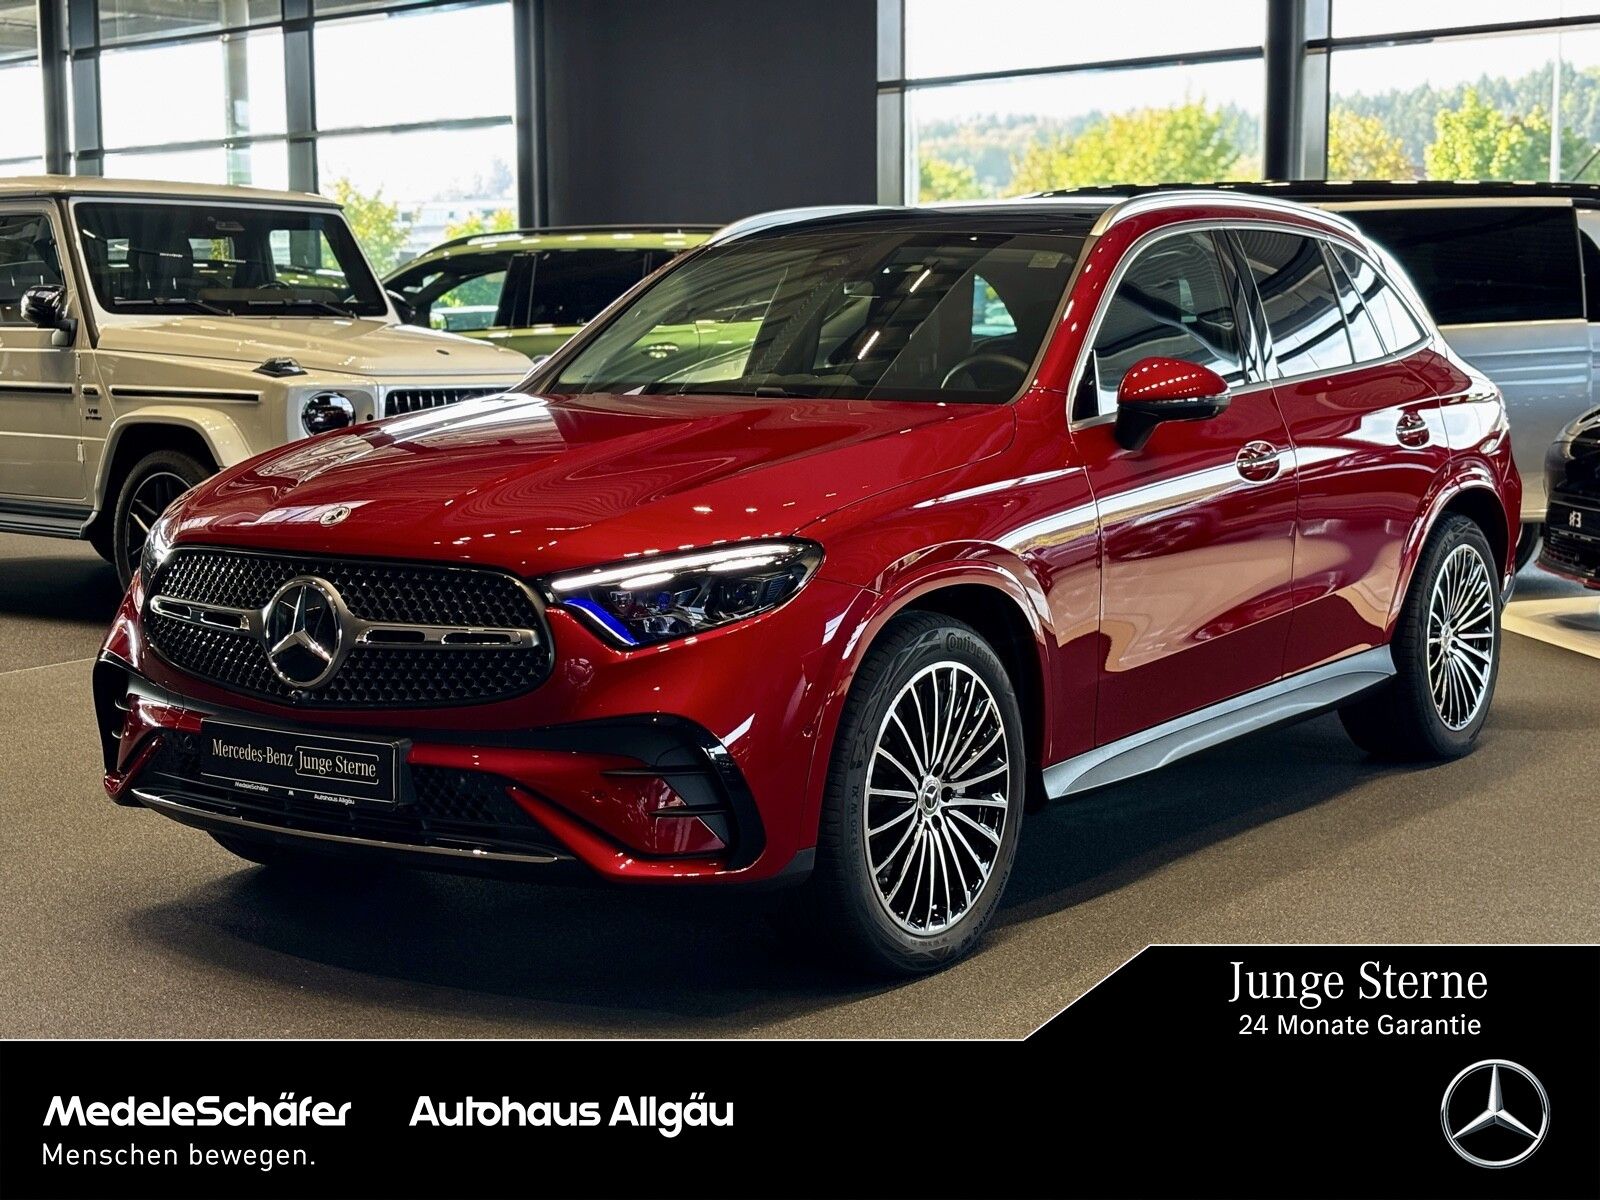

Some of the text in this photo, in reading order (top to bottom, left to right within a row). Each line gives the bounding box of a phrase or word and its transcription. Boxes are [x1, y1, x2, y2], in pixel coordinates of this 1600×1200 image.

[212, 738, 376, 777] Mercedes-Benz Junge Sterne
